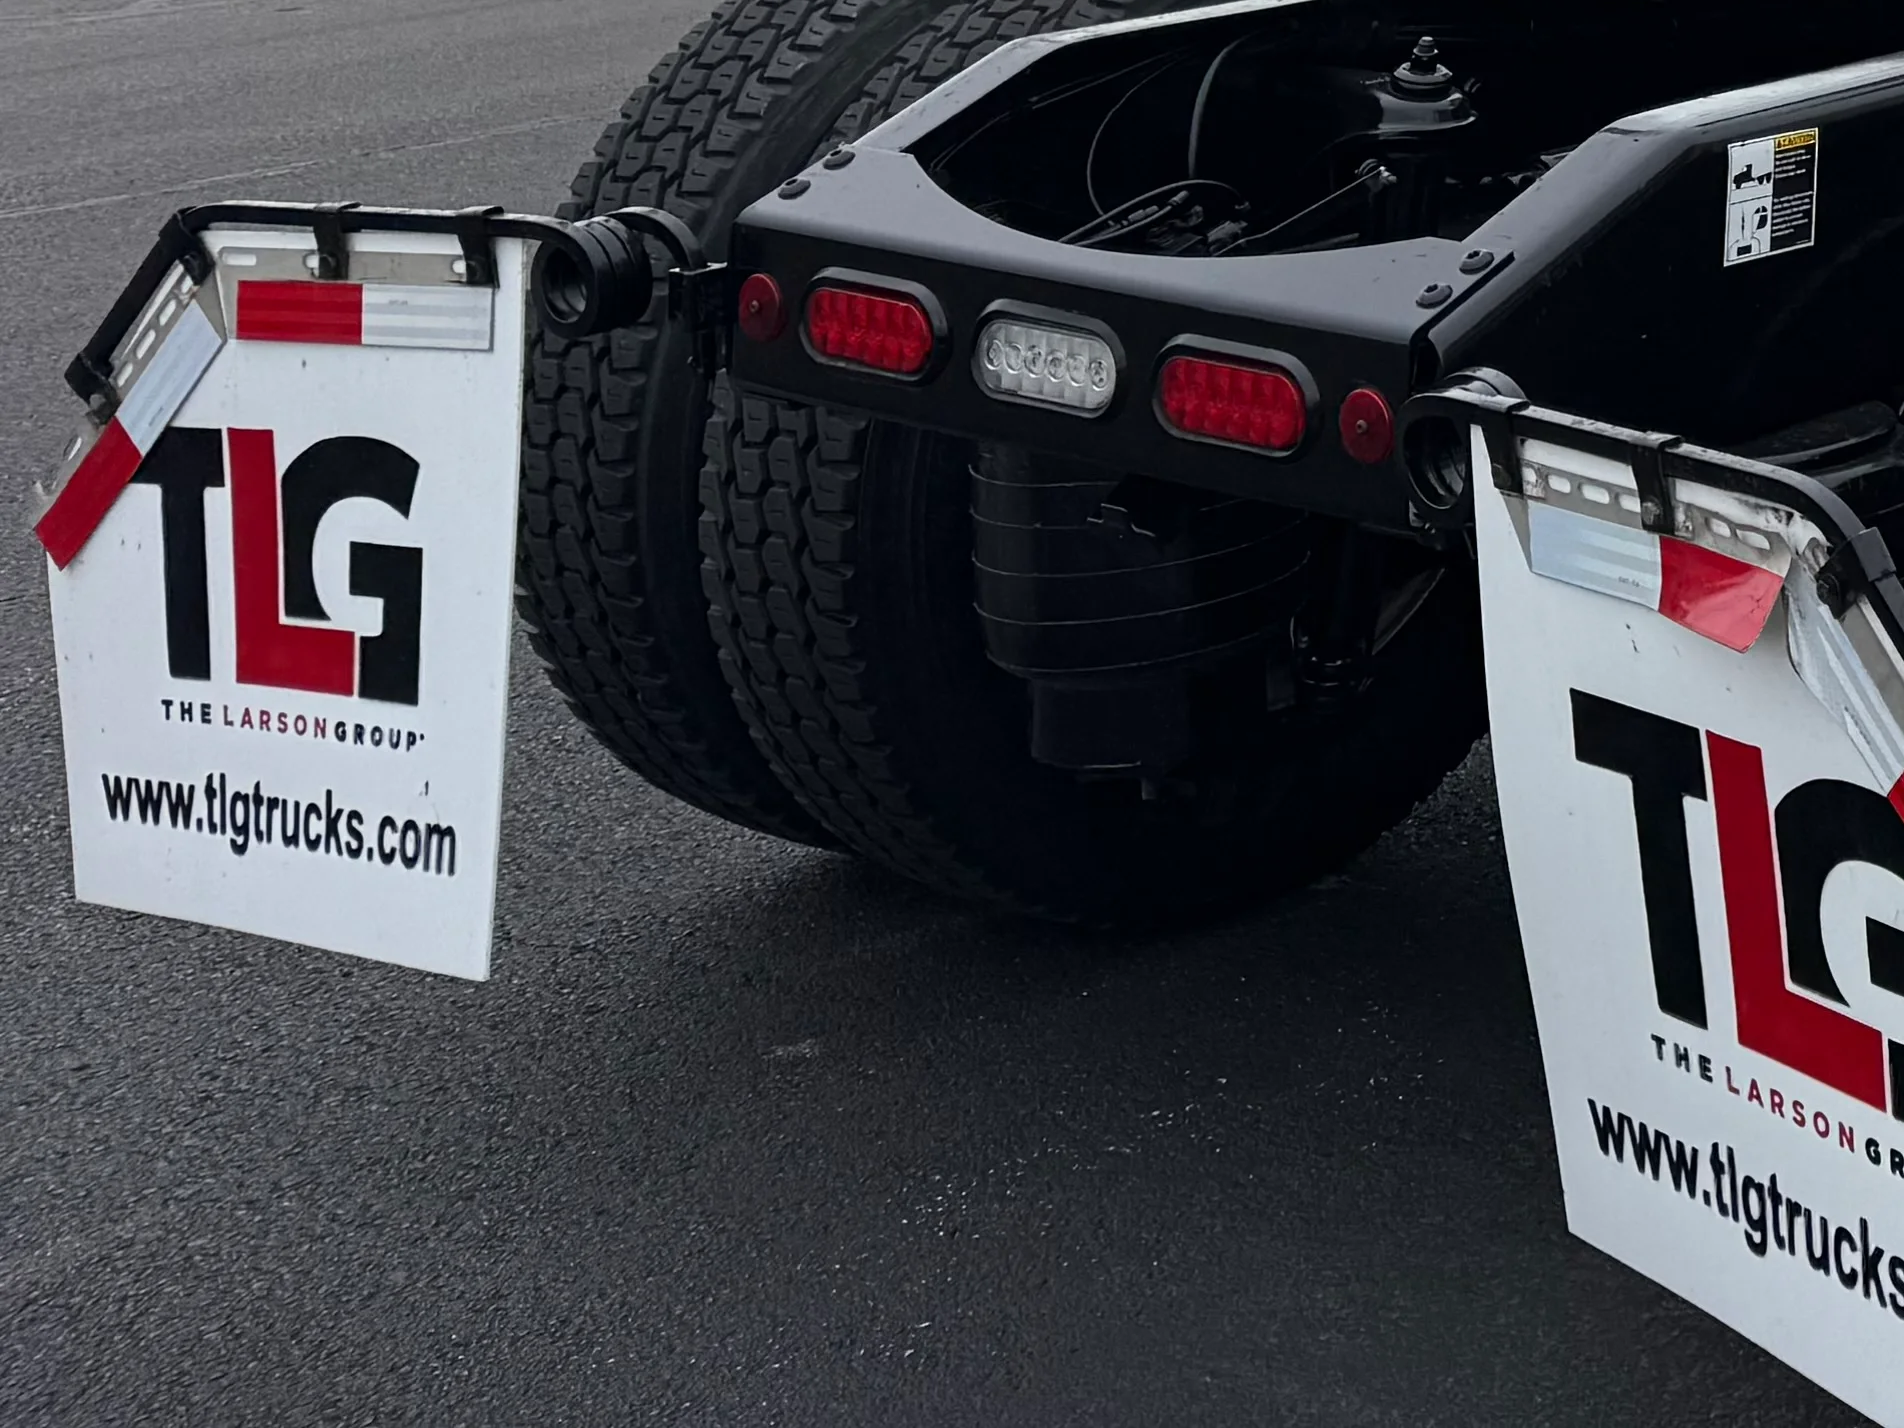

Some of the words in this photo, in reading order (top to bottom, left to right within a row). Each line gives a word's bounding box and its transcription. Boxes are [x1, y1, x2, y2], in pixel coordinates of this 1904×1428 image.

[131, 427, 424, 706] TLG
[162, 699, 213, 725] THE
[223, 704, 328, 741] LARSON
[102, 772, 457, 877] www.tlgtrucks.com
[1650, 1032, 1714, 1081] THE
[1726, 1063, 1857, 1150] LARSON
